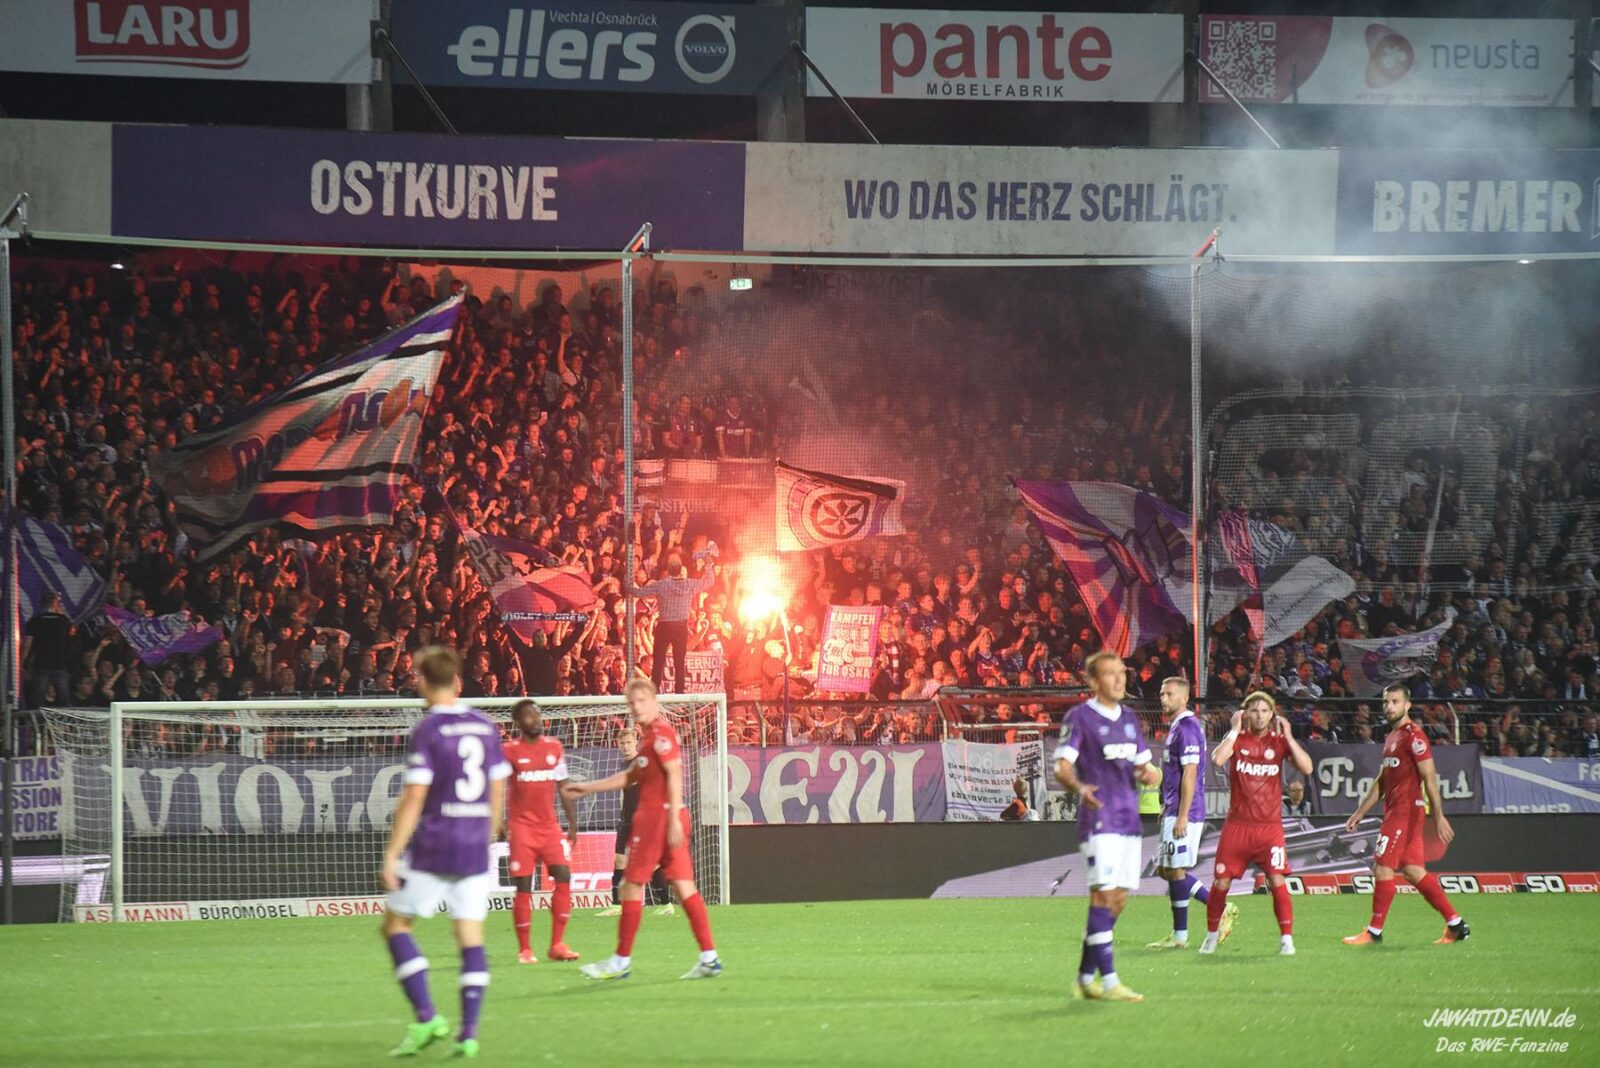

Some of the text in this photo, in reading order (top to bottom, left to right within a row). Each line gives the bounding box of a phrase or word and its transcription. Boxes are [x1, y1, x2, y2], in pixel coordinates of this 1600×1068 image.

[87, 2, 238, 49] LARU
[447, 8, 657, 82] ellers
[684, 44, 727, 54] VOLVO
[880, 14, 1112, 94] pante
[1430, 39, 1540, 69] neusta
[926, 81, 1064, 98] MÖBELFABRIK
[310, 159, 558, 221] OSTKURVE
[844, 179, 900, 220] WO
[908, 181, 977, 221] DAS
[986, 182, 1073, 222] HERZ
[1373, 179, 1584, 233] BREMER
[455, 735, 487, 802] 3
[1236, 760, 1279, 776] HARFID
[1286, 877, 1305, 895] O
[1353, 876, 1376, 894] S
[1440, 875, 1480, 894] SO
[1526, 875, 1566, 894] SO
[85, 906, 184, 922] ASMANN
[200, 903, 298, 920] BÜROMÖBEL
[314, 900, 386, 916] ASSMA
